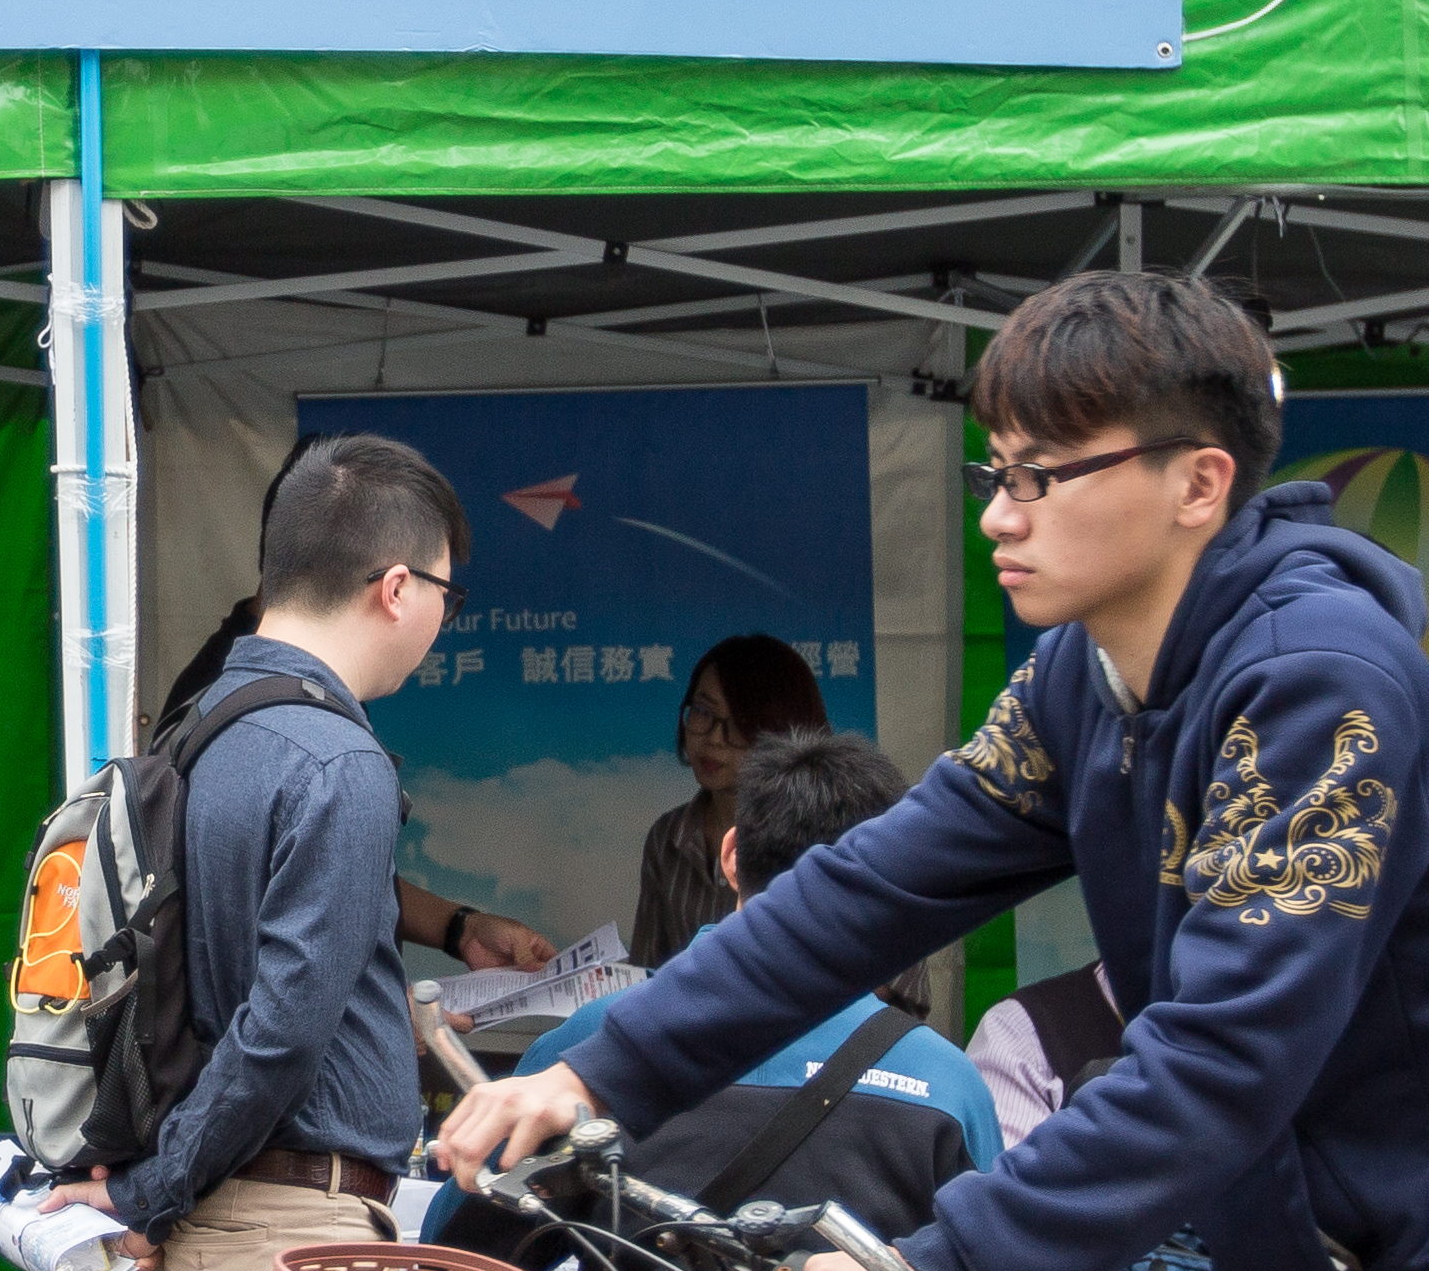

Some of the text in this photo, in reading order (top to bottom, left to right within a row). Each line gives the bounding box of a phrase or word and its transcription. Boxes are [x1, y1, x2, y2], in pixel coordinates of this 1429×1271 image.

[489, 608, 577, 632] Future
[520, 644, 675, 684] 誠信務實
